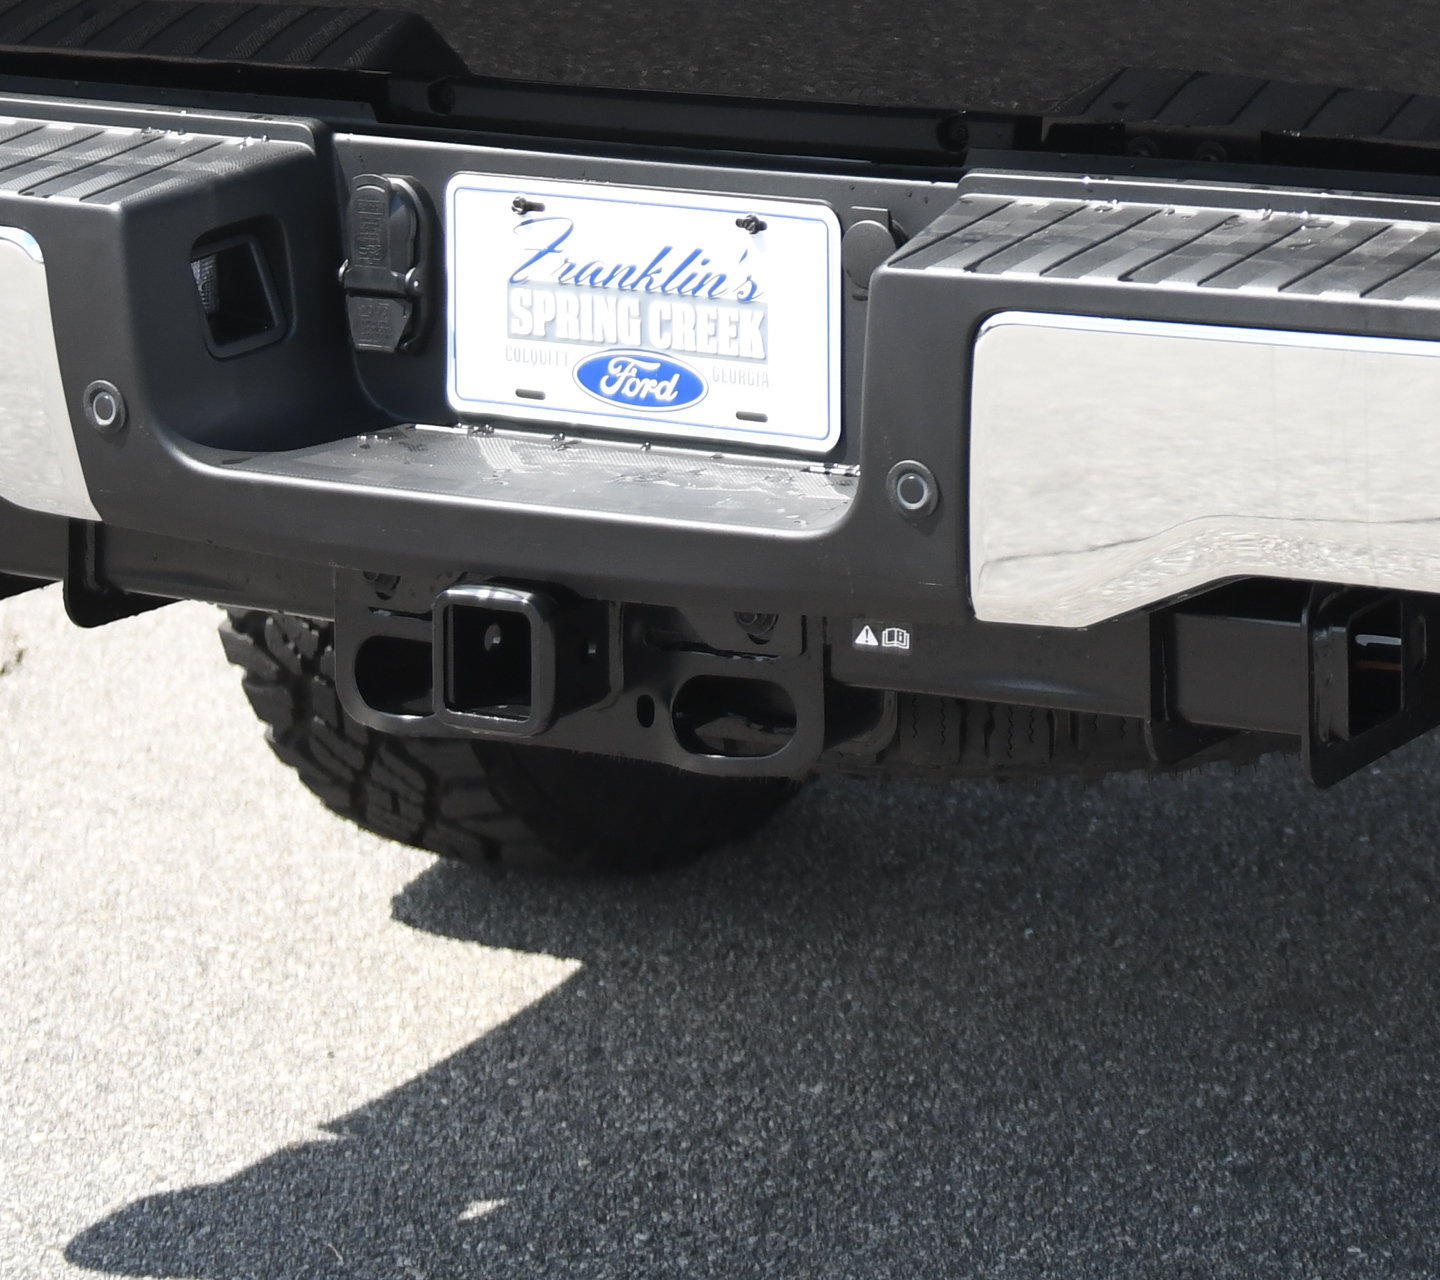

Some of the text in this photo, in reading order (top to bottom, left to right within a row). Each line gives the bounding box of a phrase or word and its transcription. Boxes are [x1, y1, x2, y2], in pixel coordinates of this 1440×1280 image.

[509, 216, 766, 304] Franklin's
[509, 286, 767, 361] SPRING CREEK
[504, 344, 570, 369] COLQUITT
[599, 355, 682, 402] Ford
[711, 365, 770, 389] GEORGIA
